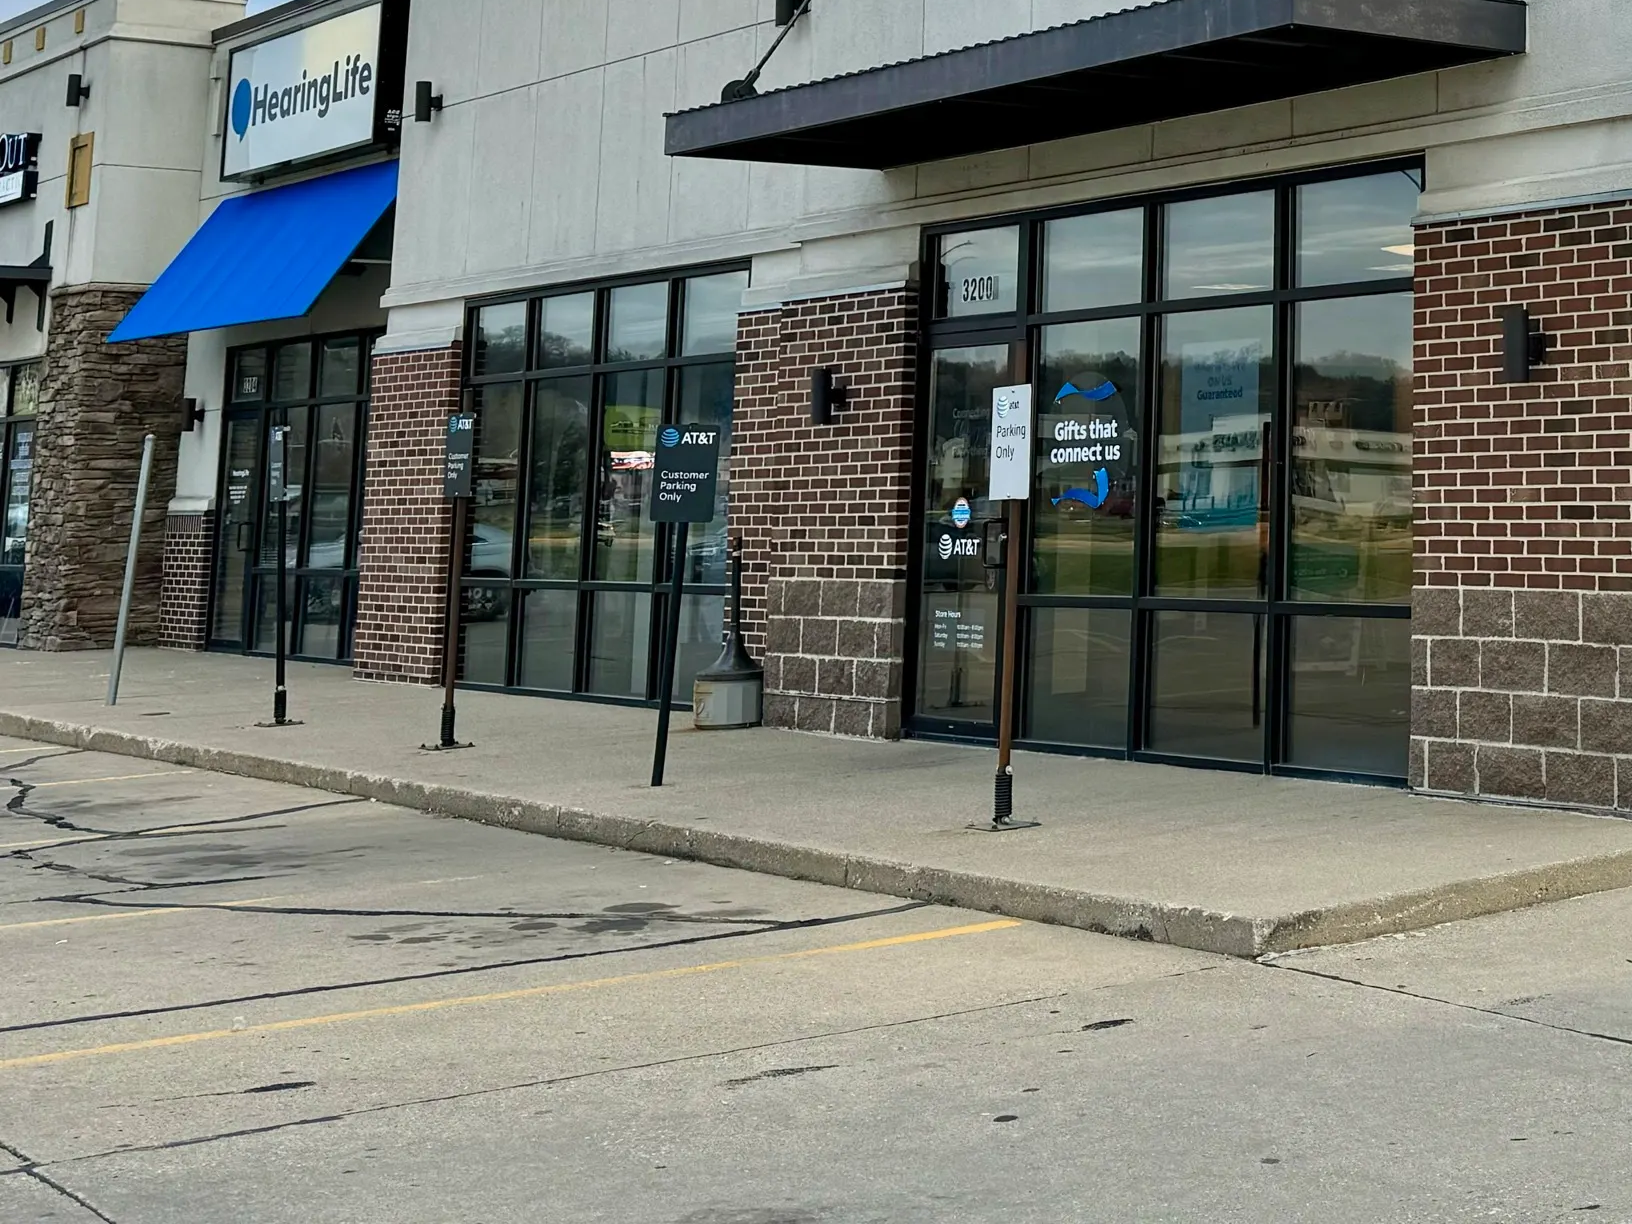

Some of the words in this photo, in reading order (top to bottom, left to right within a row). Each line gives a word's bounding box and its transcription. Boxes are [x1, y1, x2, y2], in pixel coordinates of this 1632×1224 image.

[251, 54, 372, 126] HearingLife
[962, 276, 993, 302] 3200
[1196, 386, 1243, 401] Guaranteed
[457, 418, 473, 430] AT&T
[996, 424, 1026, 439] Parking
[1054, 420, 1087, 441] Gifts
[1089, 419, 1118, 439] that
[681, 432, 716, 444] AT&T
[995, 445, 1015, 461] Only
[1050, 443, 1103, 464] connect
[1105, 445, 1121, 461] us
[447, 462, 464, 471] Parking
[661, 470, 709, 479] Customer
[660, 481, 697, 493] Parking
[659, 492, 682, 503] Only
[953, 538, 980, 556] AT&T
